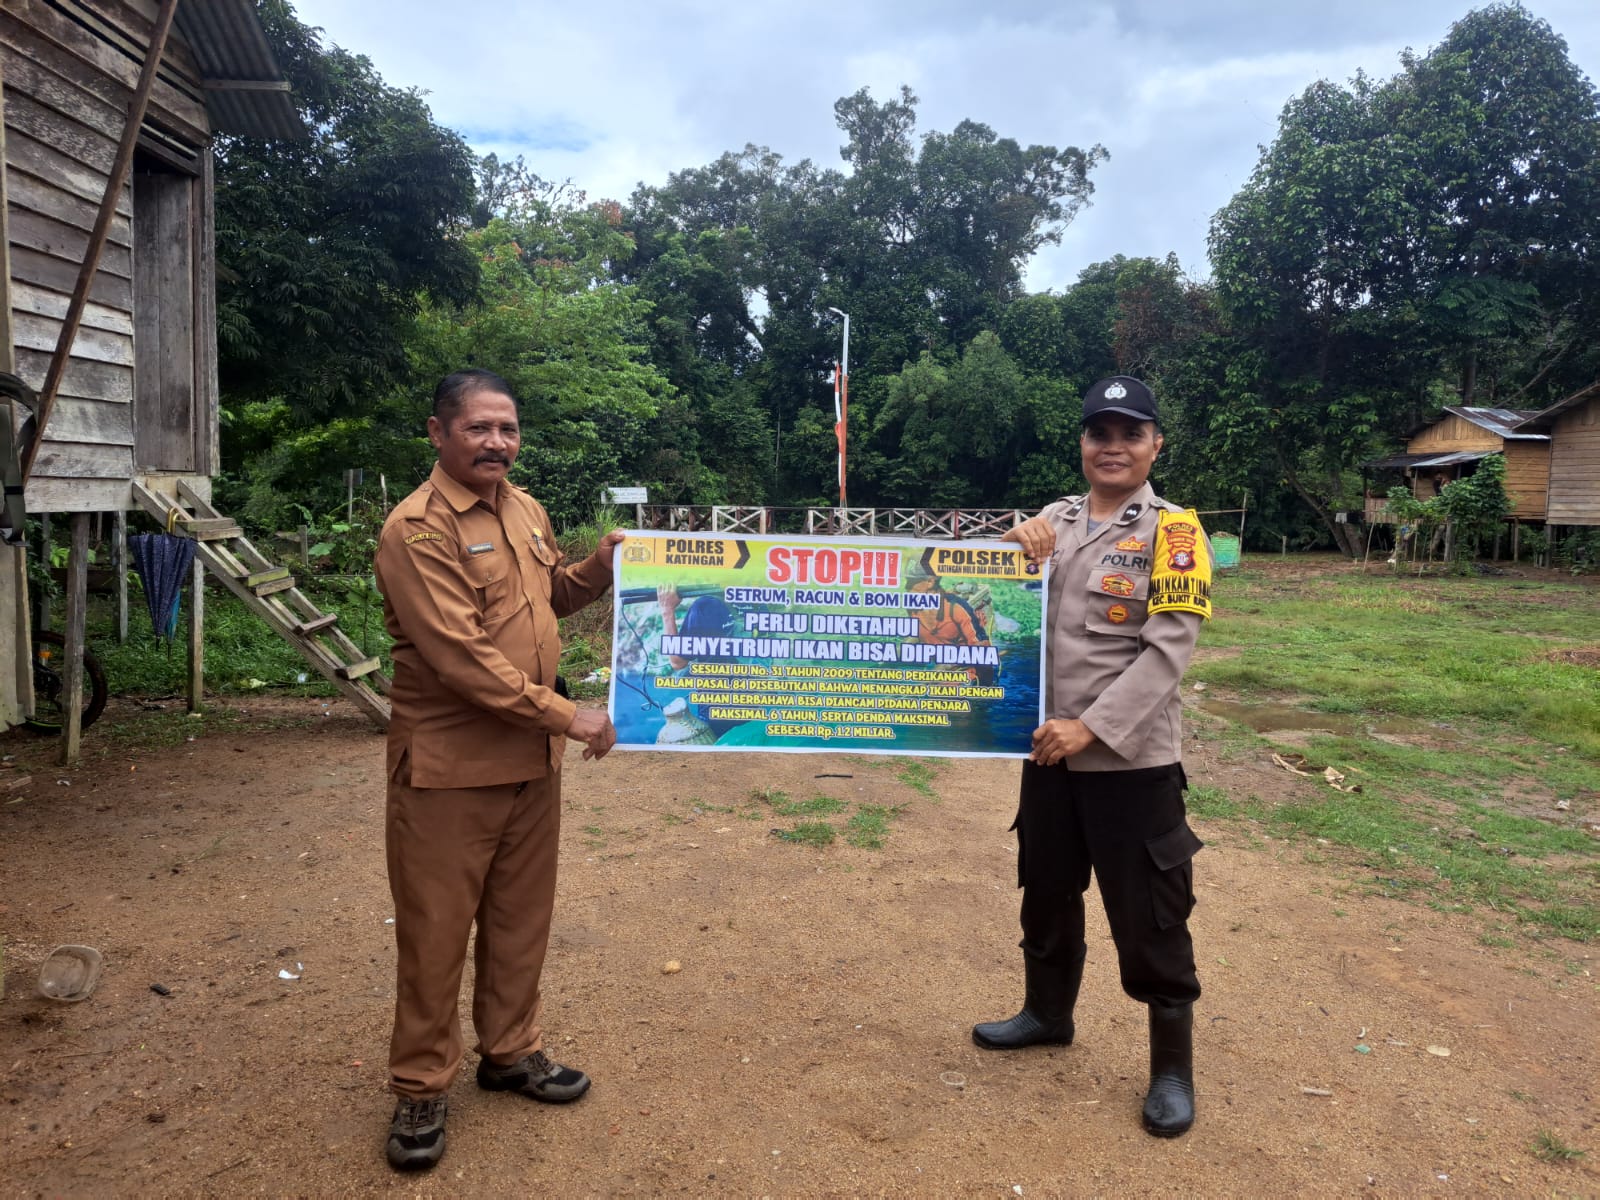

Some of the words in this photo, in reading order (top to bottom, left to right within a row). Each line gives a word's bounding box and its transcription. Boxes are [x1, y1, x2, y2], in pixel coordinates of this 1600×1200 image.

[666, 539, 724, 554] POLRES
[666, 555, 724, 566] KATINGAN
[768, 547, 899, 585] STOP!!!
[938, 550, 1016, 566] POLSEK
[1101, 554, 1148, 570] POLRI
[725, 588, 791, 606] SETRUM,
[796, 590, 844, 604] RACUN
[849, 592, 859, 605] &
[864, 593, 899, 607] BOM
[904, 594, 939, 608] IKAN
[745, 613, 807, 633] PERLU
[812, 615, 918, 636] DIKETAHUI
[662, 636, 789, 658] MENYETRUM
[794, 640, 844, 660] IKAN
[848, 642, 897, 662] BISA
[901, 644, 998, 665] DIPIDANA
[691, 664, 730, 675] SESUAI
[733, 665, 748, 675] UU
[750, 666, 769, 676] No.
[771, 666, 783, 676] 31
[785, 666, 820, 678] TAHUN
[823, 668, 854, 678] 2009
[856, 669, 903, 680] TENTANG
[905, 670, 969, 683] PERIKANAN,
[656, 677, 694, 688] DALAM
[696, 679, 731, 689] PASAL
[733, 679, 746, 690] 84
[749, 680, 816, 692] DISEBUTKAN
[819, 682, 859, 693] BAHWA
[861, 684, 927, 696] MENANGKAP
[929, 686, 957, 697] IKAN
[959, 687, 1003, 698] DENGAN
[691, 693, 730, 704] BAHAN
[732, 694, 795, 706] BERBAHAYA
[797, 696, 823, 706] BISA
[826, 697, 875, 708] DIANCAM
[877, 698, 918, 709] PIDANA
[921, 700, 969, 711] PENJARA
[711, 709, 768, 720] MAKSIMAL
[770, 710, 777, 720] 6
[781, 710, 819, 722] TAHUN,
[821, 712, 853, 722] SERTA
[856, 713, 892, 723] DENDA
[894, 714, 949, 725] MAKSIMAL
[767, 725, 815, 736] SEBESAR
[817, 726, 835, 739] Rp.
[853, 728, 895, 738] MILIAR.
